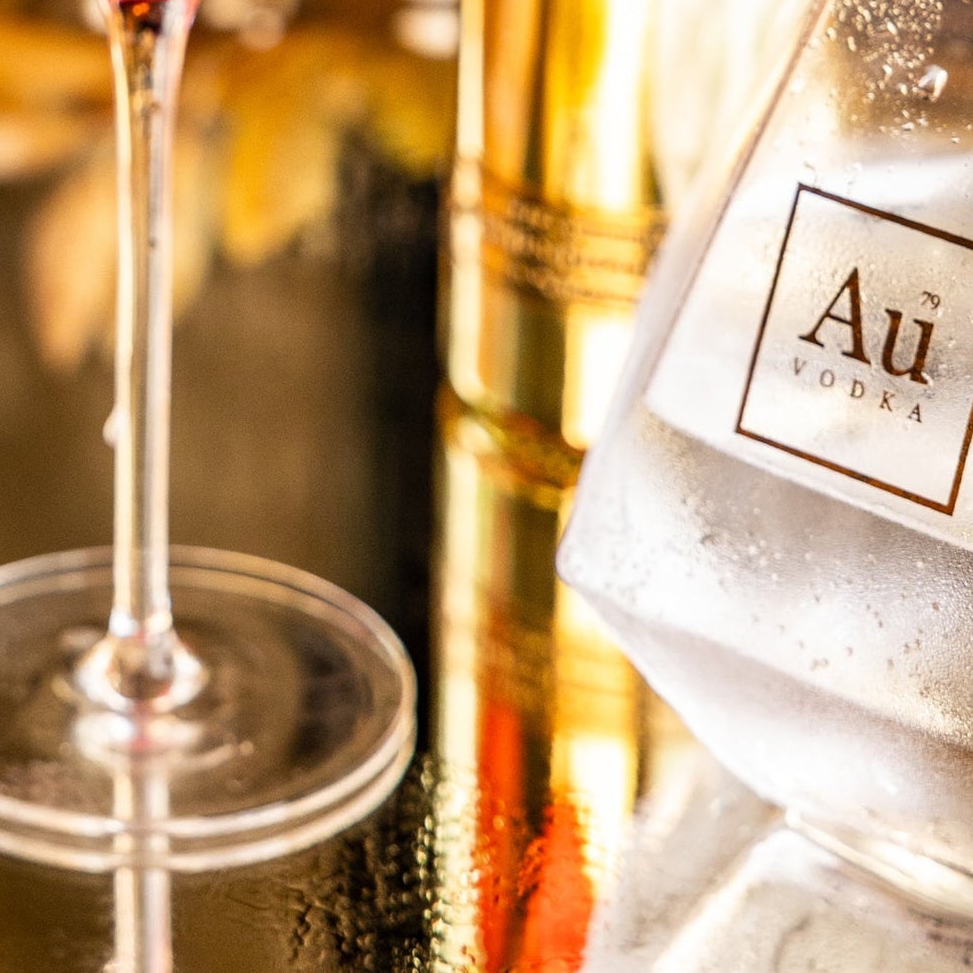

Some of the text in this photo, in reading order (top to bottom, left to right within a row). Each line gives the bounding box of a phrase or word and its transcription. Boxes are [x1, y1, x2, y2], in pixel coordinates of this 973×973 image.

[798, 267, 935, 385] Au
[921, 291, 941, 308] 79
[793, 356, 923, 424] VODKA
